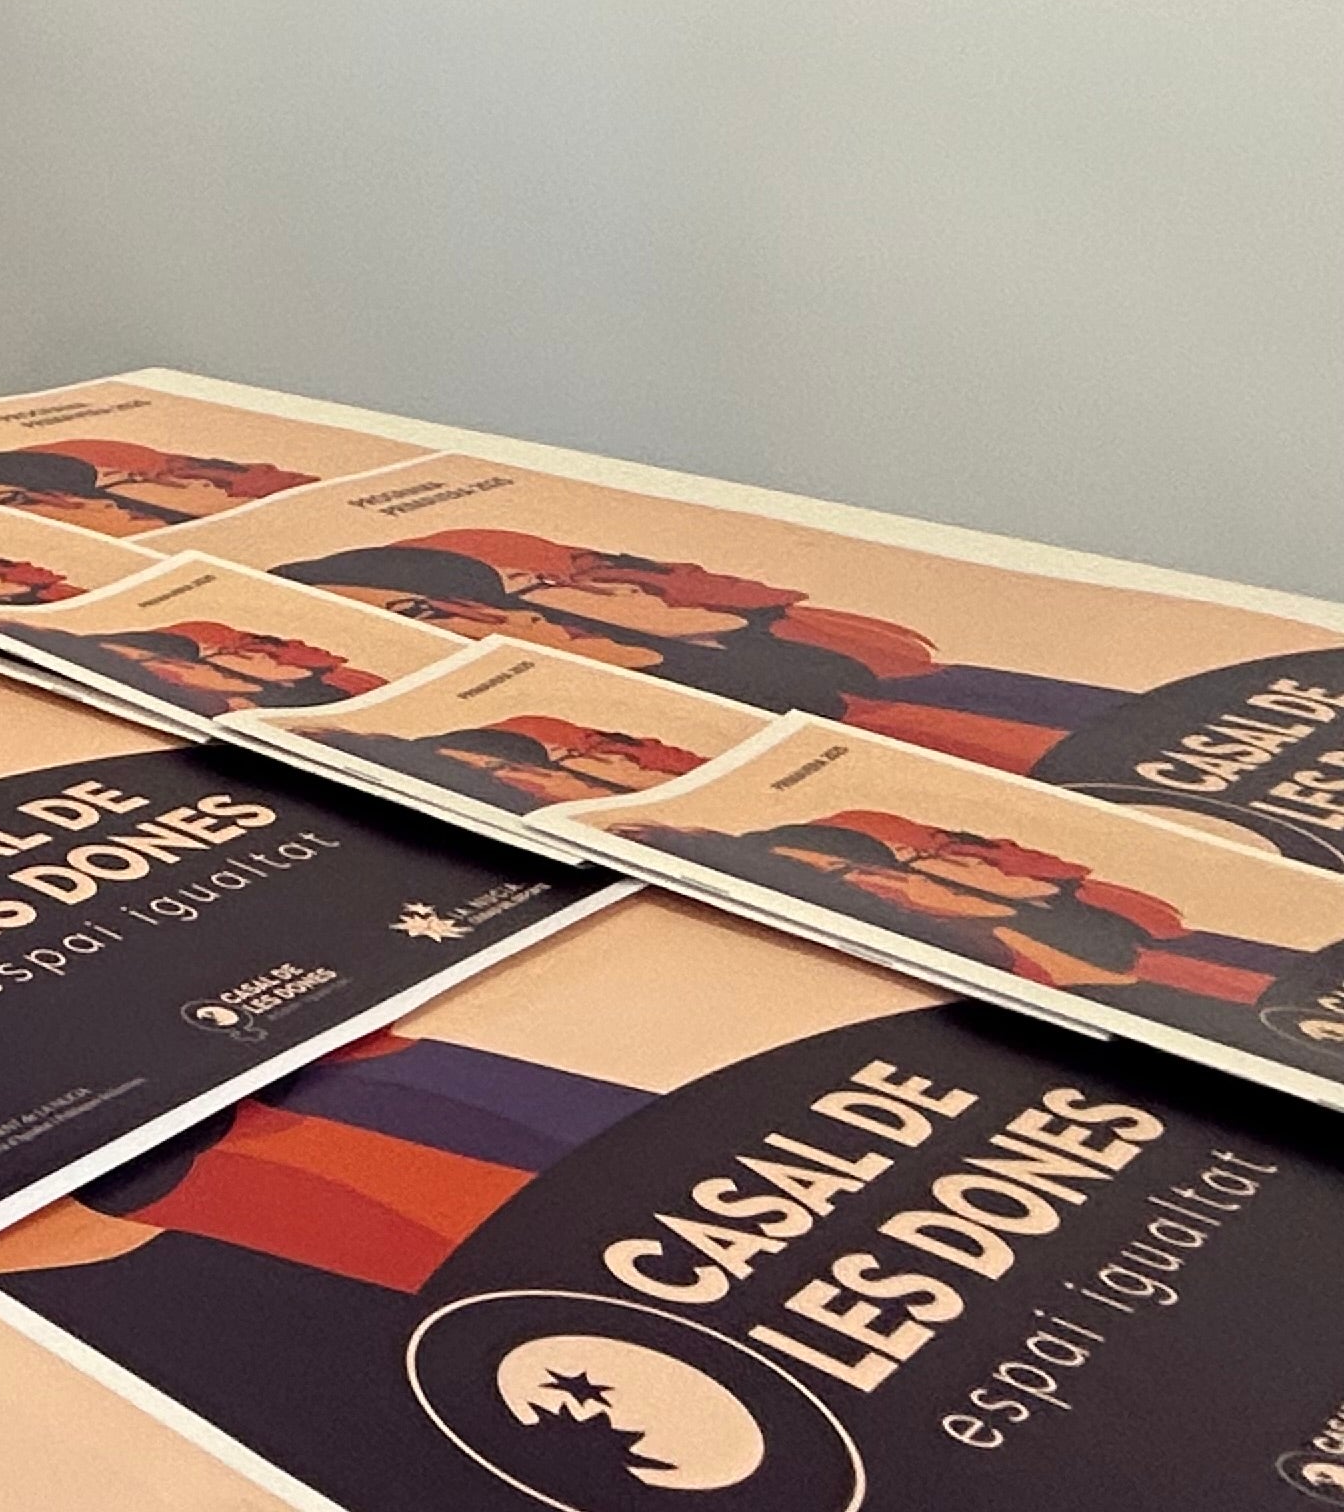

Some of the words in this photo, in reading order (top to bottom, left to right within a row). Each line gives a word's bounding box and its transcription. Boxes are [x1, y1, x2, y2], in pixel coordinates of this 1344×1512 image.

[1136, 714, 1315, 792] CASAL
[8, 793, 277, 905] DONES
[17, 780, 151, 832] DE
[120, 829, 343, 926] igualtat
[219, 971, 281, 1006] CASAL
[601, 1132, 895, 1305] CASAL
[810, 1058, 981, 1149] DE
[747, 1252, 965, 1393] LES
[876, 1087, 1166, 1282] DONES
[941, 1307, 1106, 1450] espai
[1064, 1148, 1279, 1314] igualtat
